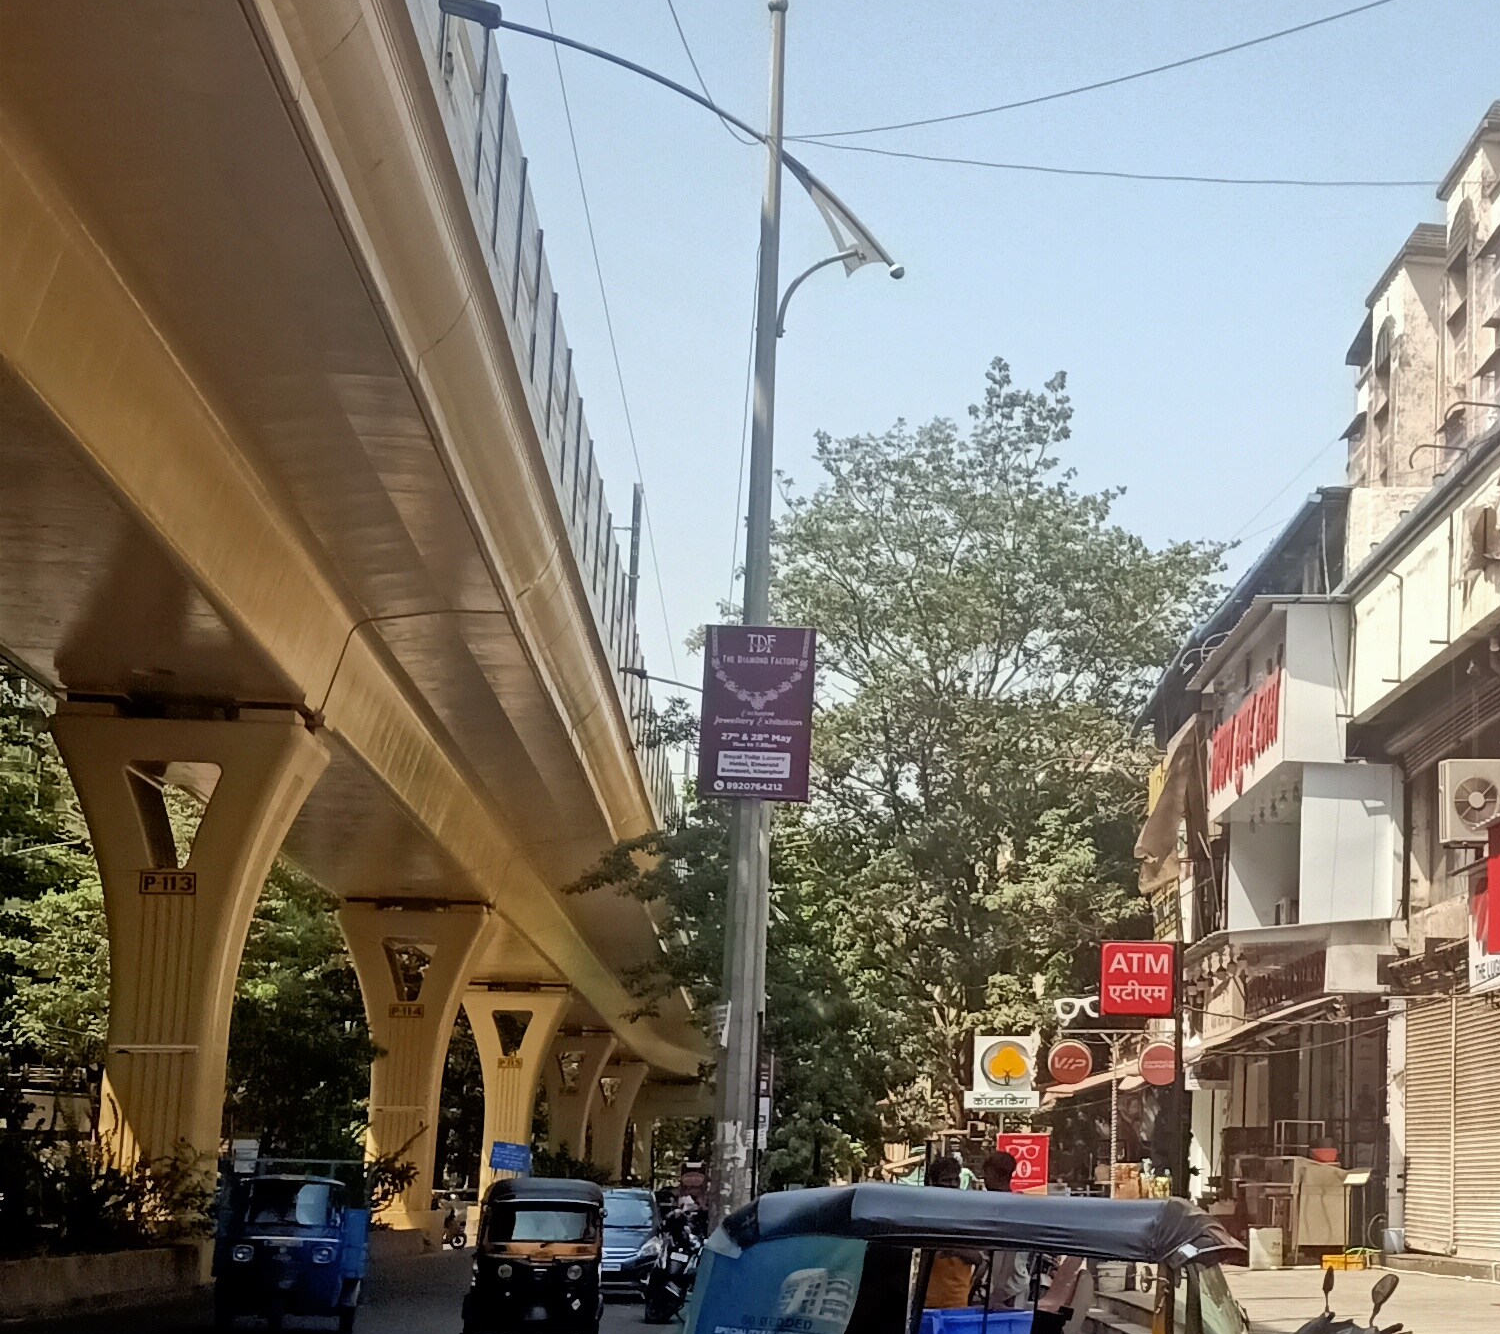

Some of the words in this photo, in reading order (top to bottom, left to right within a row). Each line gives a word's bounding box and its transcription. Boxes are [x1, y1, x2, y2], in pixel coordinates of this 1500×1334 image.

[747, 634, 776, 653] TDF
[772, 735, 792, 744] May
[144, 876, 193, 892] P-113
[1109, 953, 1169, 974] ATM
[1474, 960, 1487, 981] THE
[1108, 980, 1168, 1003] एटीएम
[1054, 1056, 1087, 1069] VIP
